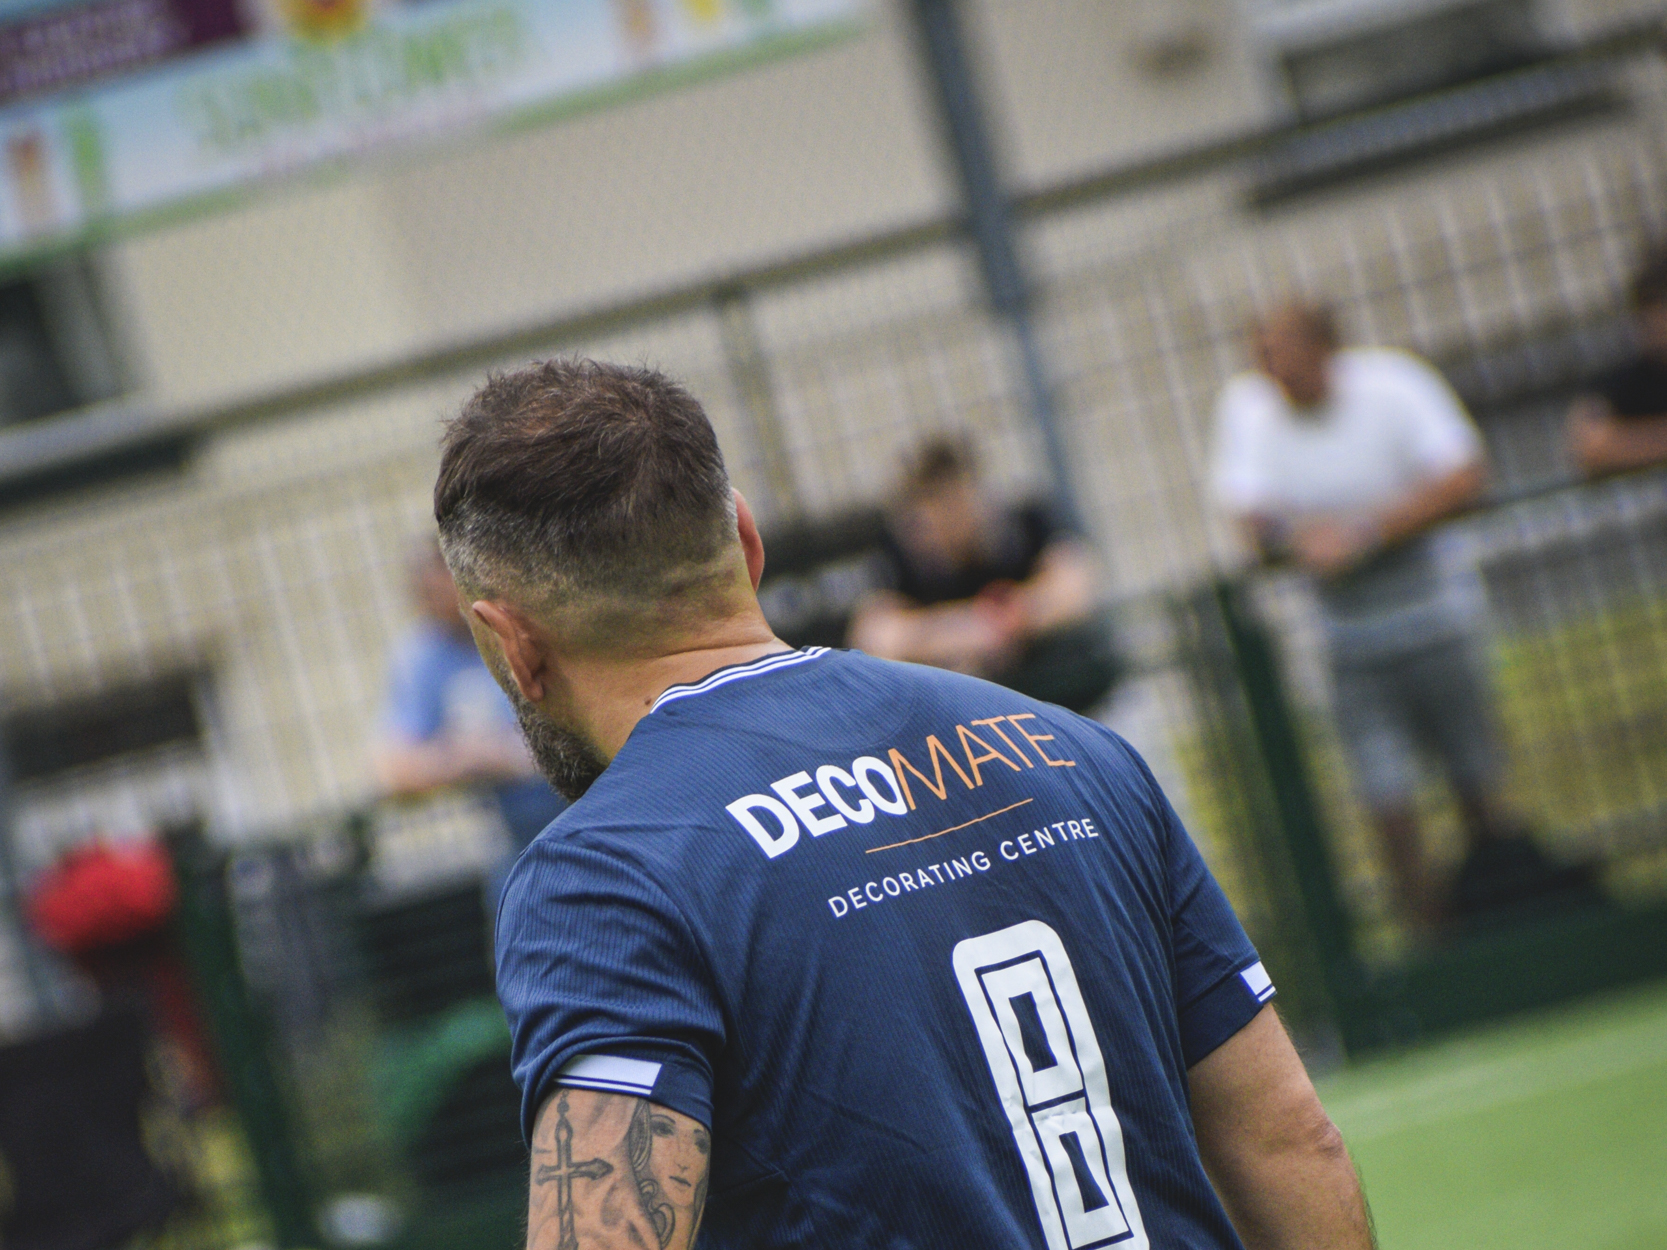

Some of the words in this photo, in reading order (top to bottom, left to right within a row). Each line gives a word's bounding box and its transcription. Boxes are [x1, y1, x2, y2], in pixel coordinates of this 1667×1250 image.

[725, 712, 1076, 860] DECOMATE
[828, 850, 992, 918] DECORATING
[1000, 817, 1099, 861] CENTRE
